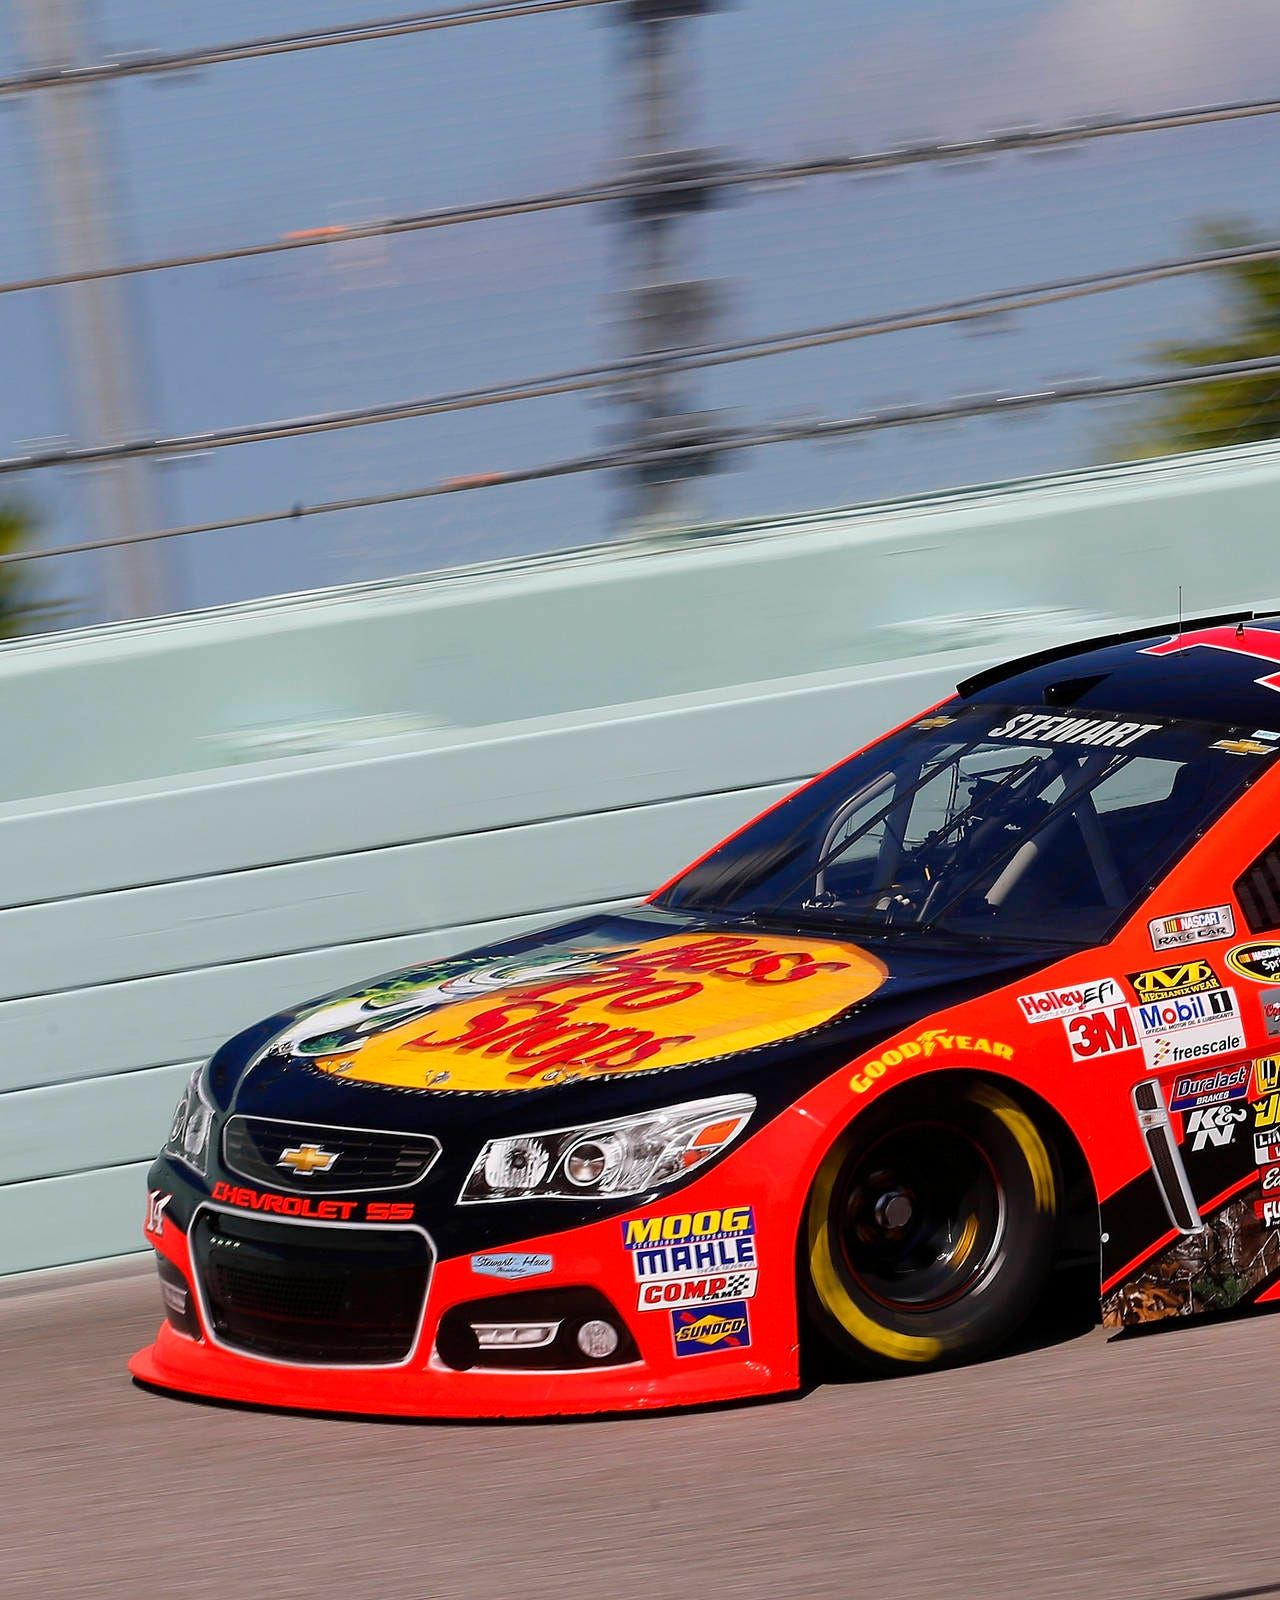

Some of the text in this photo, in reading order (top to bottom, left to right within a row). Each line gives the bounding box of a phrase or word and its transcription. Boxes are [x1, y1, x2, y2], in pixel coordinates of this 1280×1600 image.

[987, 712, 1163, 748] STEWART
[1158, 927, 1226, 945] RACE CAR
[1181, 912, 1219, 931] NASCAR
[601, 936, 851, 985] Bass
[502, 965, 705, 1014] Pro
[1020, 990, 1086, 1015] Holley
[1139, 987, 1191, 1004] MECHANIX
[1139, 991, 1230, 1029] Mobil 1
[404, 998, 696, 1083] Shops
[1069, 1009, 1137, 1057] 3M
[1173, 1036, 1239, 1062] freescale
[1176, 1067, 1246, 1097] Duralast
[1196, 1091, 1230, 1105] BRAKES
[211, 1181, 415, 1221] CHEVROLET SS
[625, 1206, 751, 1244] MOOG
[636, 1238, 754, 1276] MAHLE
[644, 1277, 727, 1304] COMP
[701, 1289, 742, 1301] CAMS
[680, 1319, 743, 1340] SUNOCO
